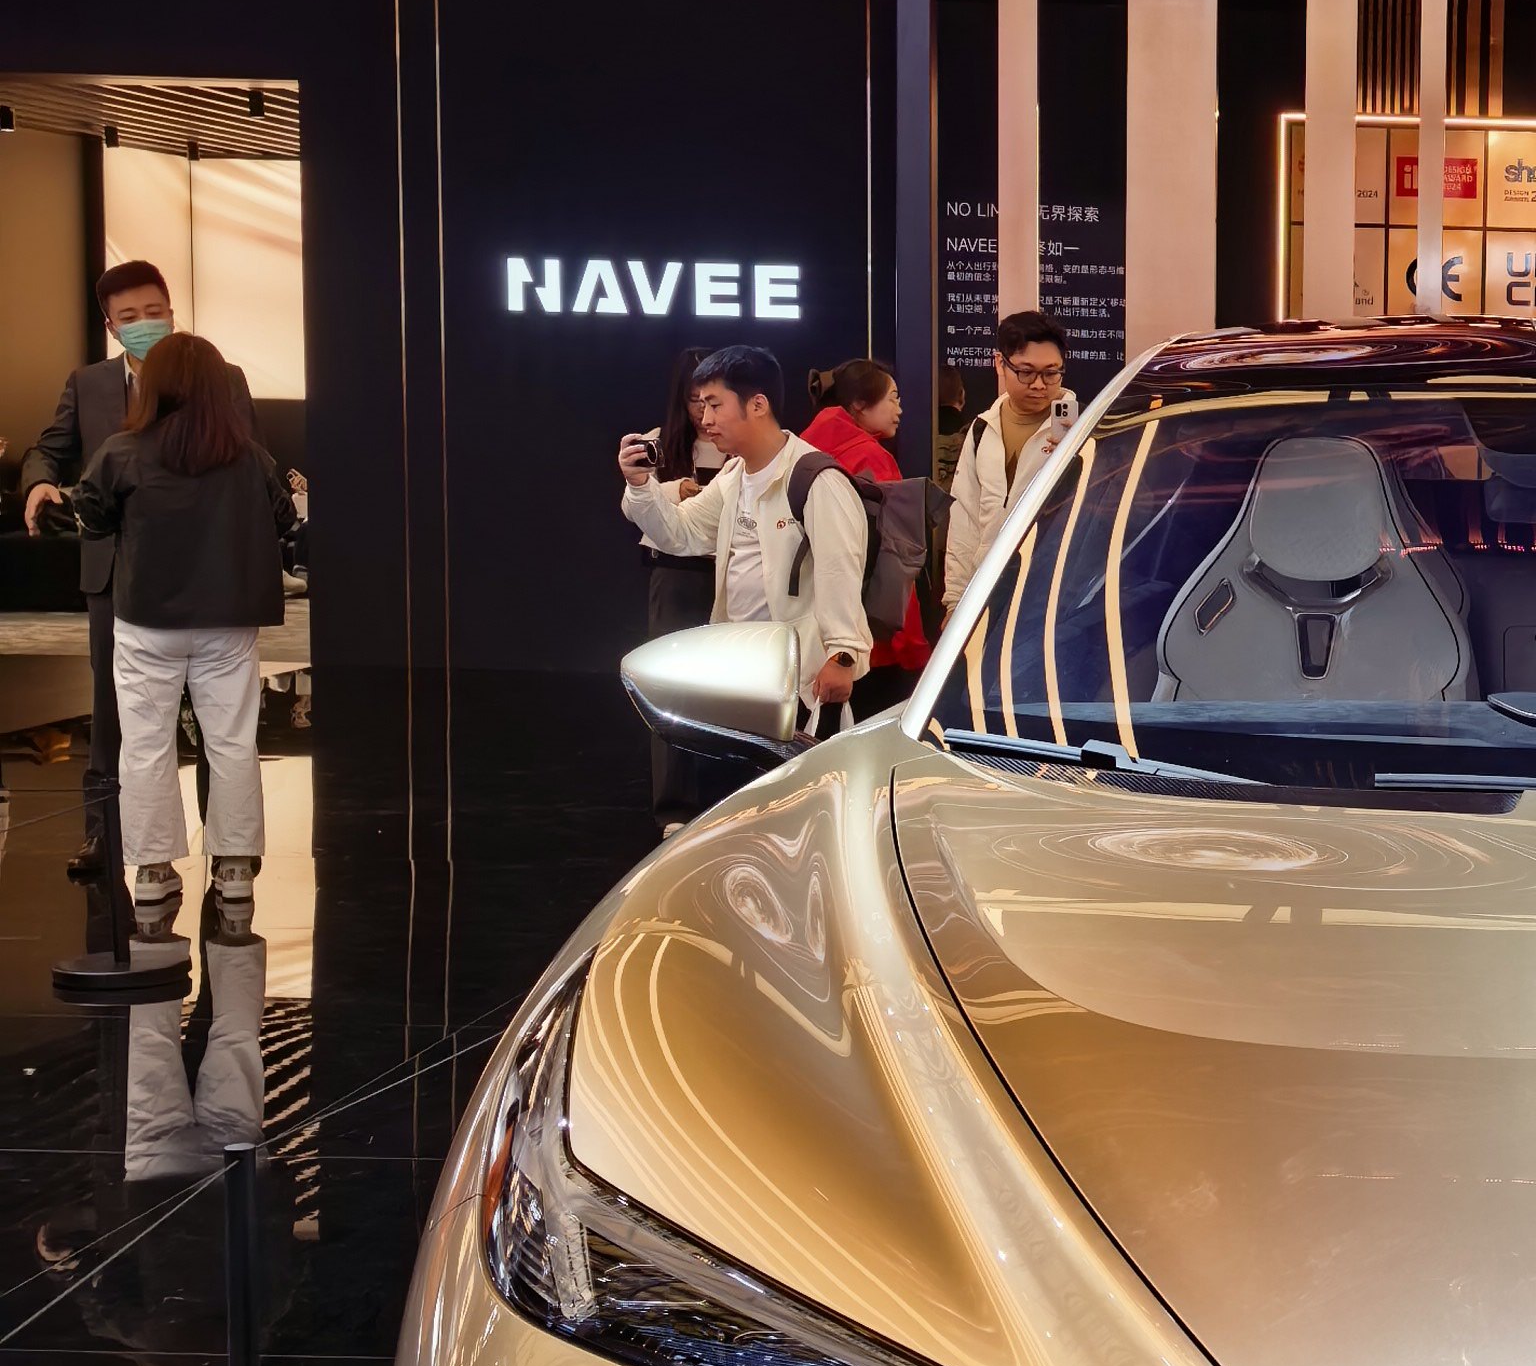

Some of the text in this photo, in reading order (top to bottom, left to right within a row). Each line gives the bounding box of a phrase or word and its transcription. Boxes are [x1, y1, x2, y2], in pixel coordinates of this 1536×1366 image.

[946, 201, 971, 217] NO
[946, 237, 998, 253] NAVEE
[506, 257, 800, 319] NAVEE
